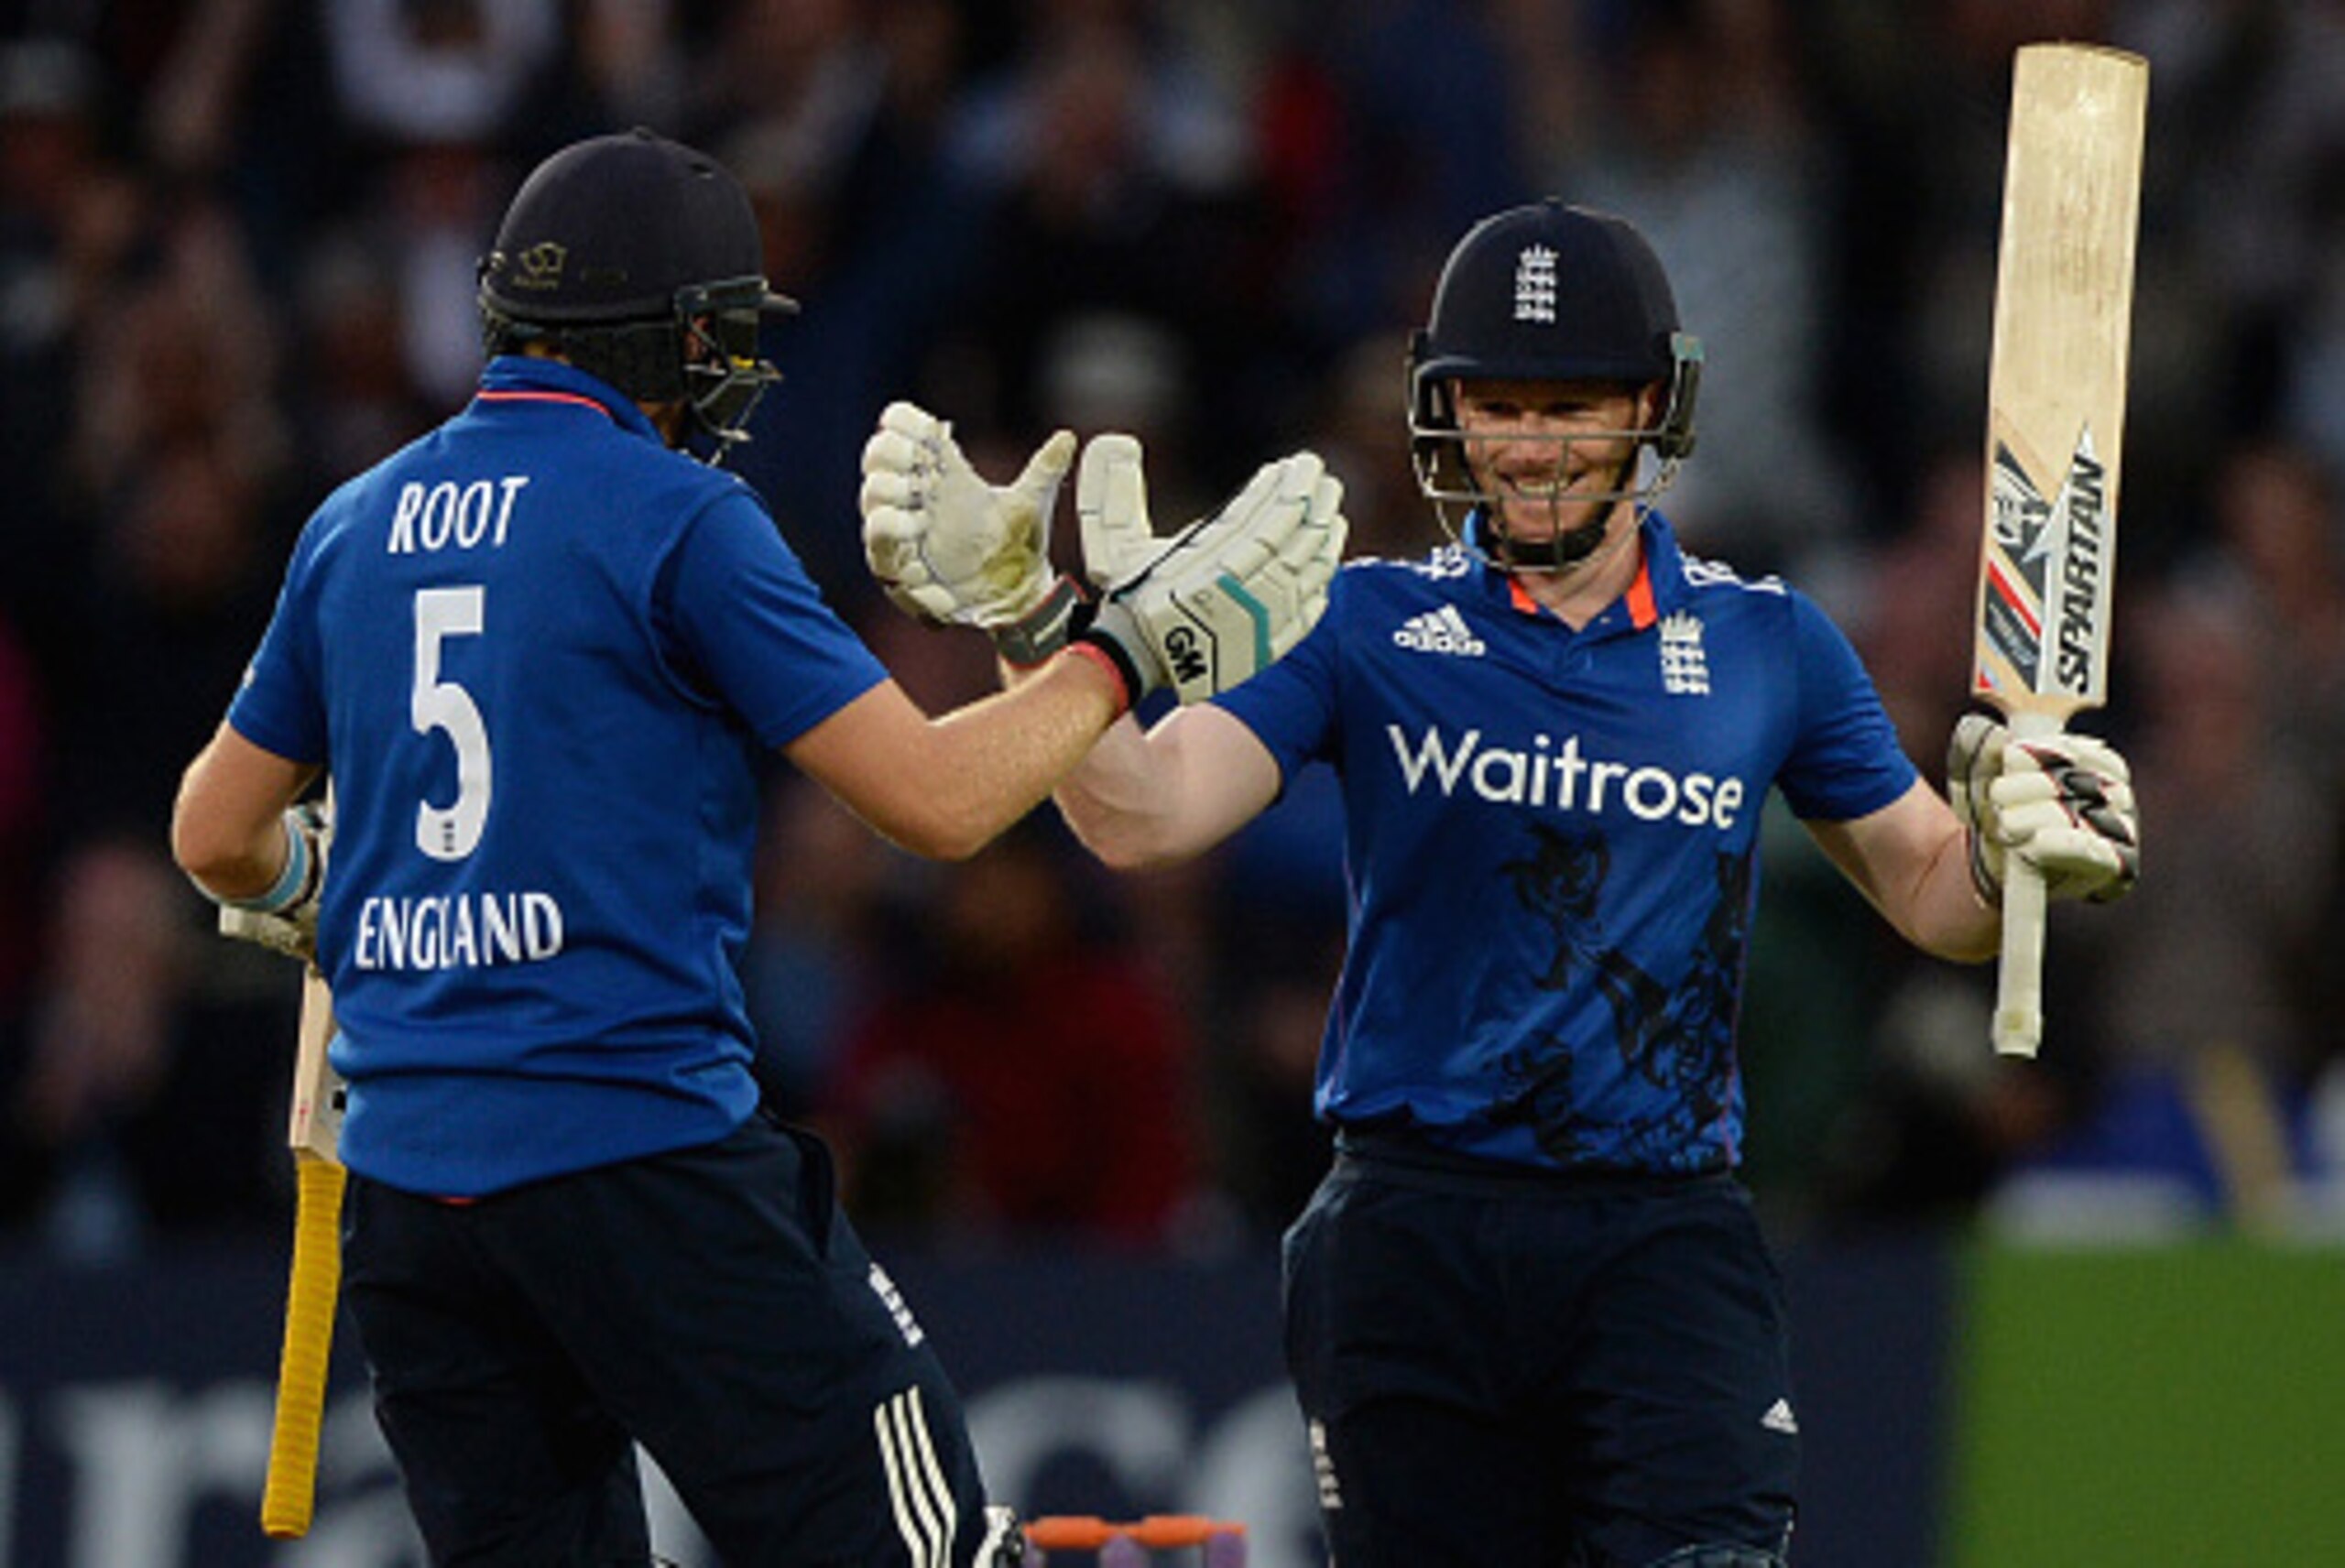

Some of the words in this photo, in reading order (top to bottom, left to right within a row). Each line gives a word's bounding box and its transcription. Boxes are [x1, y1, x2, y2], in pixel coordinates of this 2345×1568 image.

[387, 476, 529, 553] ROOT
[2055, 452, 2105, 695] SPARTAN
[1164, 626, 1207, 684] GM
[411, 585, 492, 861] 5
[1386, 724, 1744, 829] Waitrose
[354, 892, 563, 971] ENGLAND
